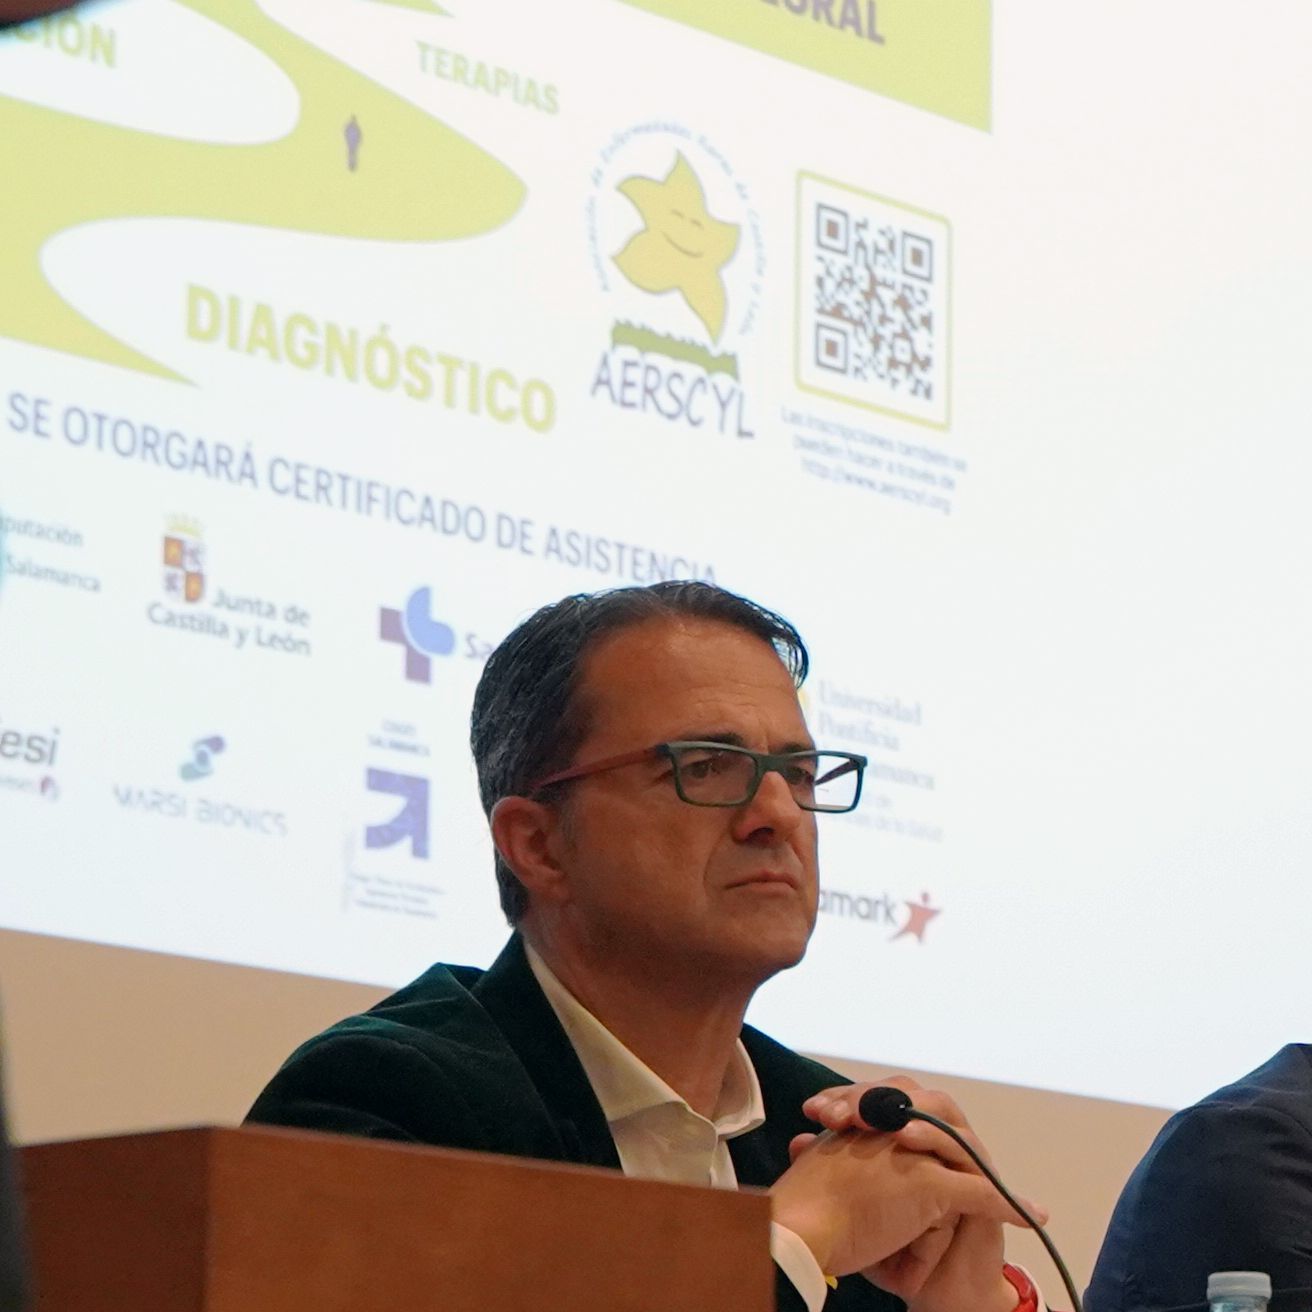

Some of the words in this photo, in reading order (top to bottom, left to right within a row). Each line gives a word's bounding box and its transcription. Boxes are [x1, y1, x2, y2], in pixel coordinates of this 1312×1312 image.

[415, 40, 560, 115] TERAPIAS
[185, 283, 557, 434] DIAGNÓSTICO
[590, 352, 755, 439] AERSCYL
[8, 391, 51, 438] SE
[63, 406, 258, 490] OTORGARÁ
[269, 456, 486, 543] CERTIFICADO
[496, 512, 534, 556] DE
[148, 602, 230, 639] Castilla
[235, 628, 249, 649] y
[256, 625, 312, 657] León
[213, 588, 277, 620] Junta
[284, 605, 311, 628] de
[0, 727, 61, 768] esi
[819, 889, 898, 926] amark
